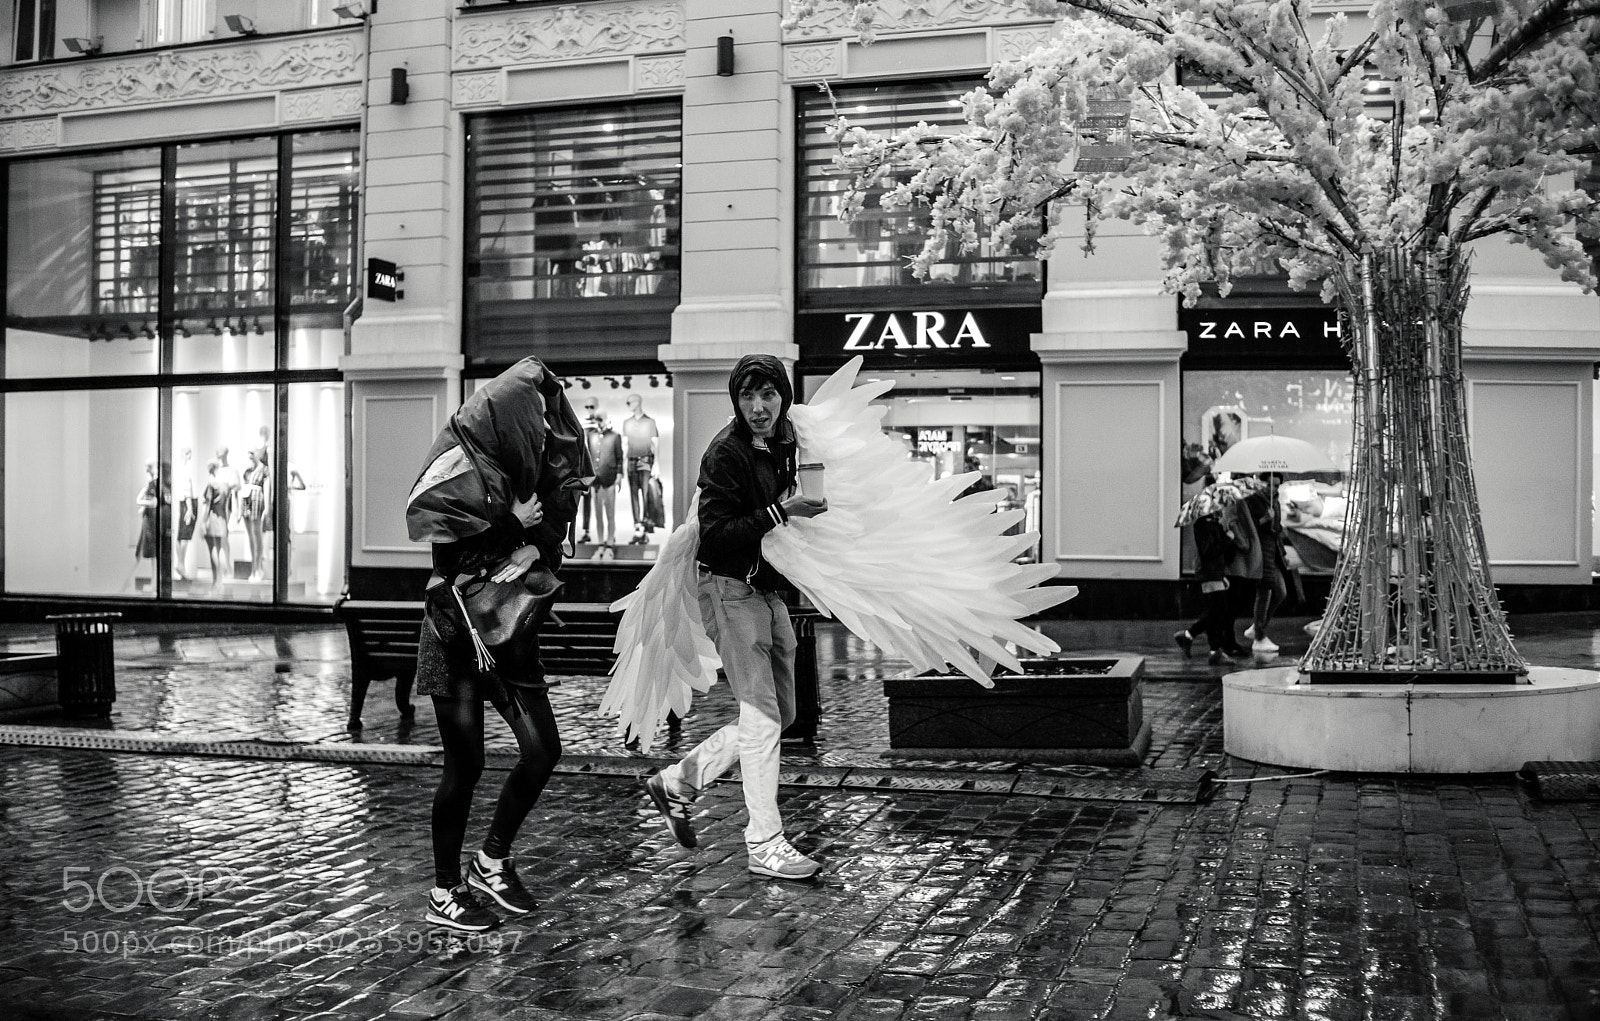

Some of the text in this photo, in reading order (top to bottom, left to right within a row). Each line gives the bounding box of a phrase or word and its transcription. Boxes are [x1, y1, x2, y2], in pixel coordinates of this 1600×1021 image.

[375, 272, 396, 288] ZARA
[843, 311, 991, 350] ZARA
[1199, 321, 1301, 338] ZARA
[765, 855, 785, 872] N
[443, 902, 466, 920] N
